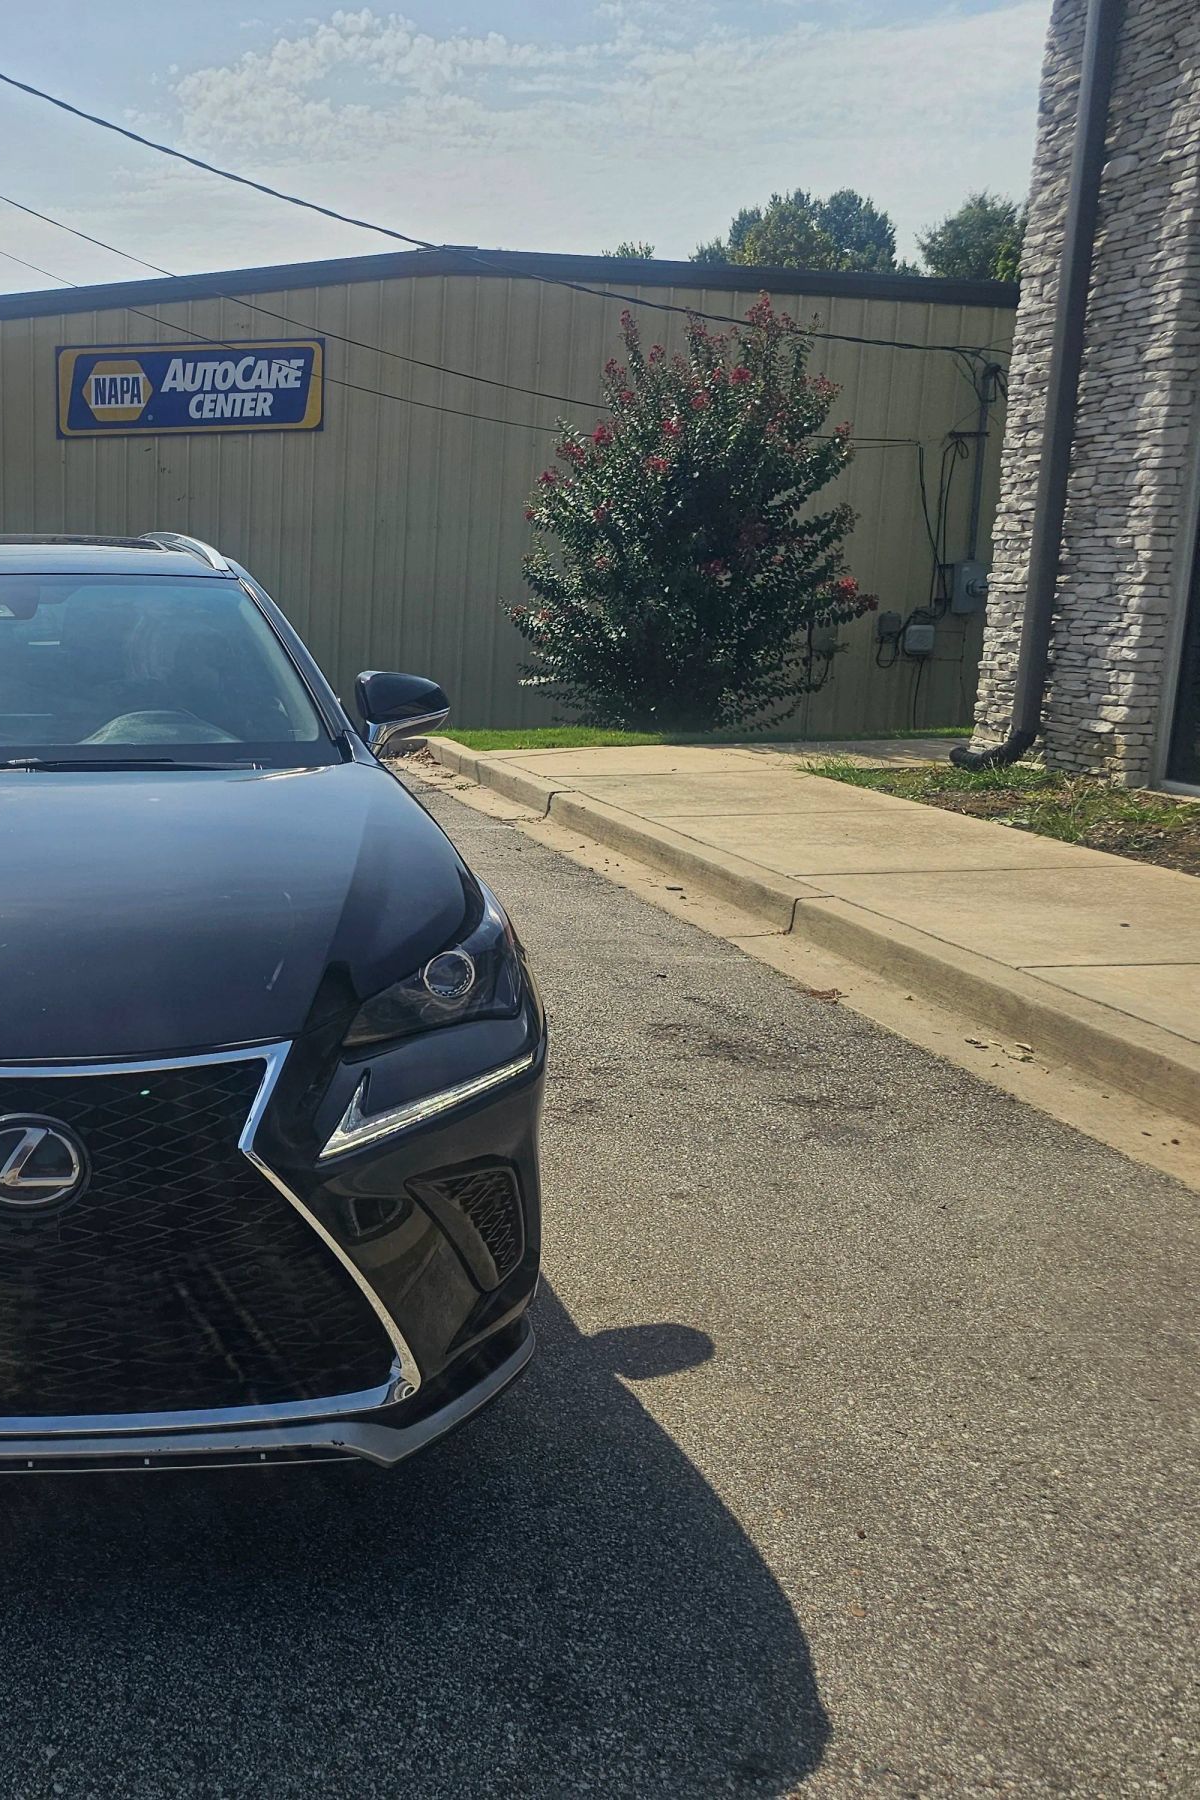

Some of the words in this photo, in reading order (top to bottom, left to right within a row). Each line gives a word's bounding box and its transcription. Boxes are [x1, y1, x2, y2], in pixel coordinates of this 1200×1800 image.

[160, 356, 305, 393] AUTOCARE
[94, 376, 142, 406] NAPA
[188, 391, 274, 419] CENTER
